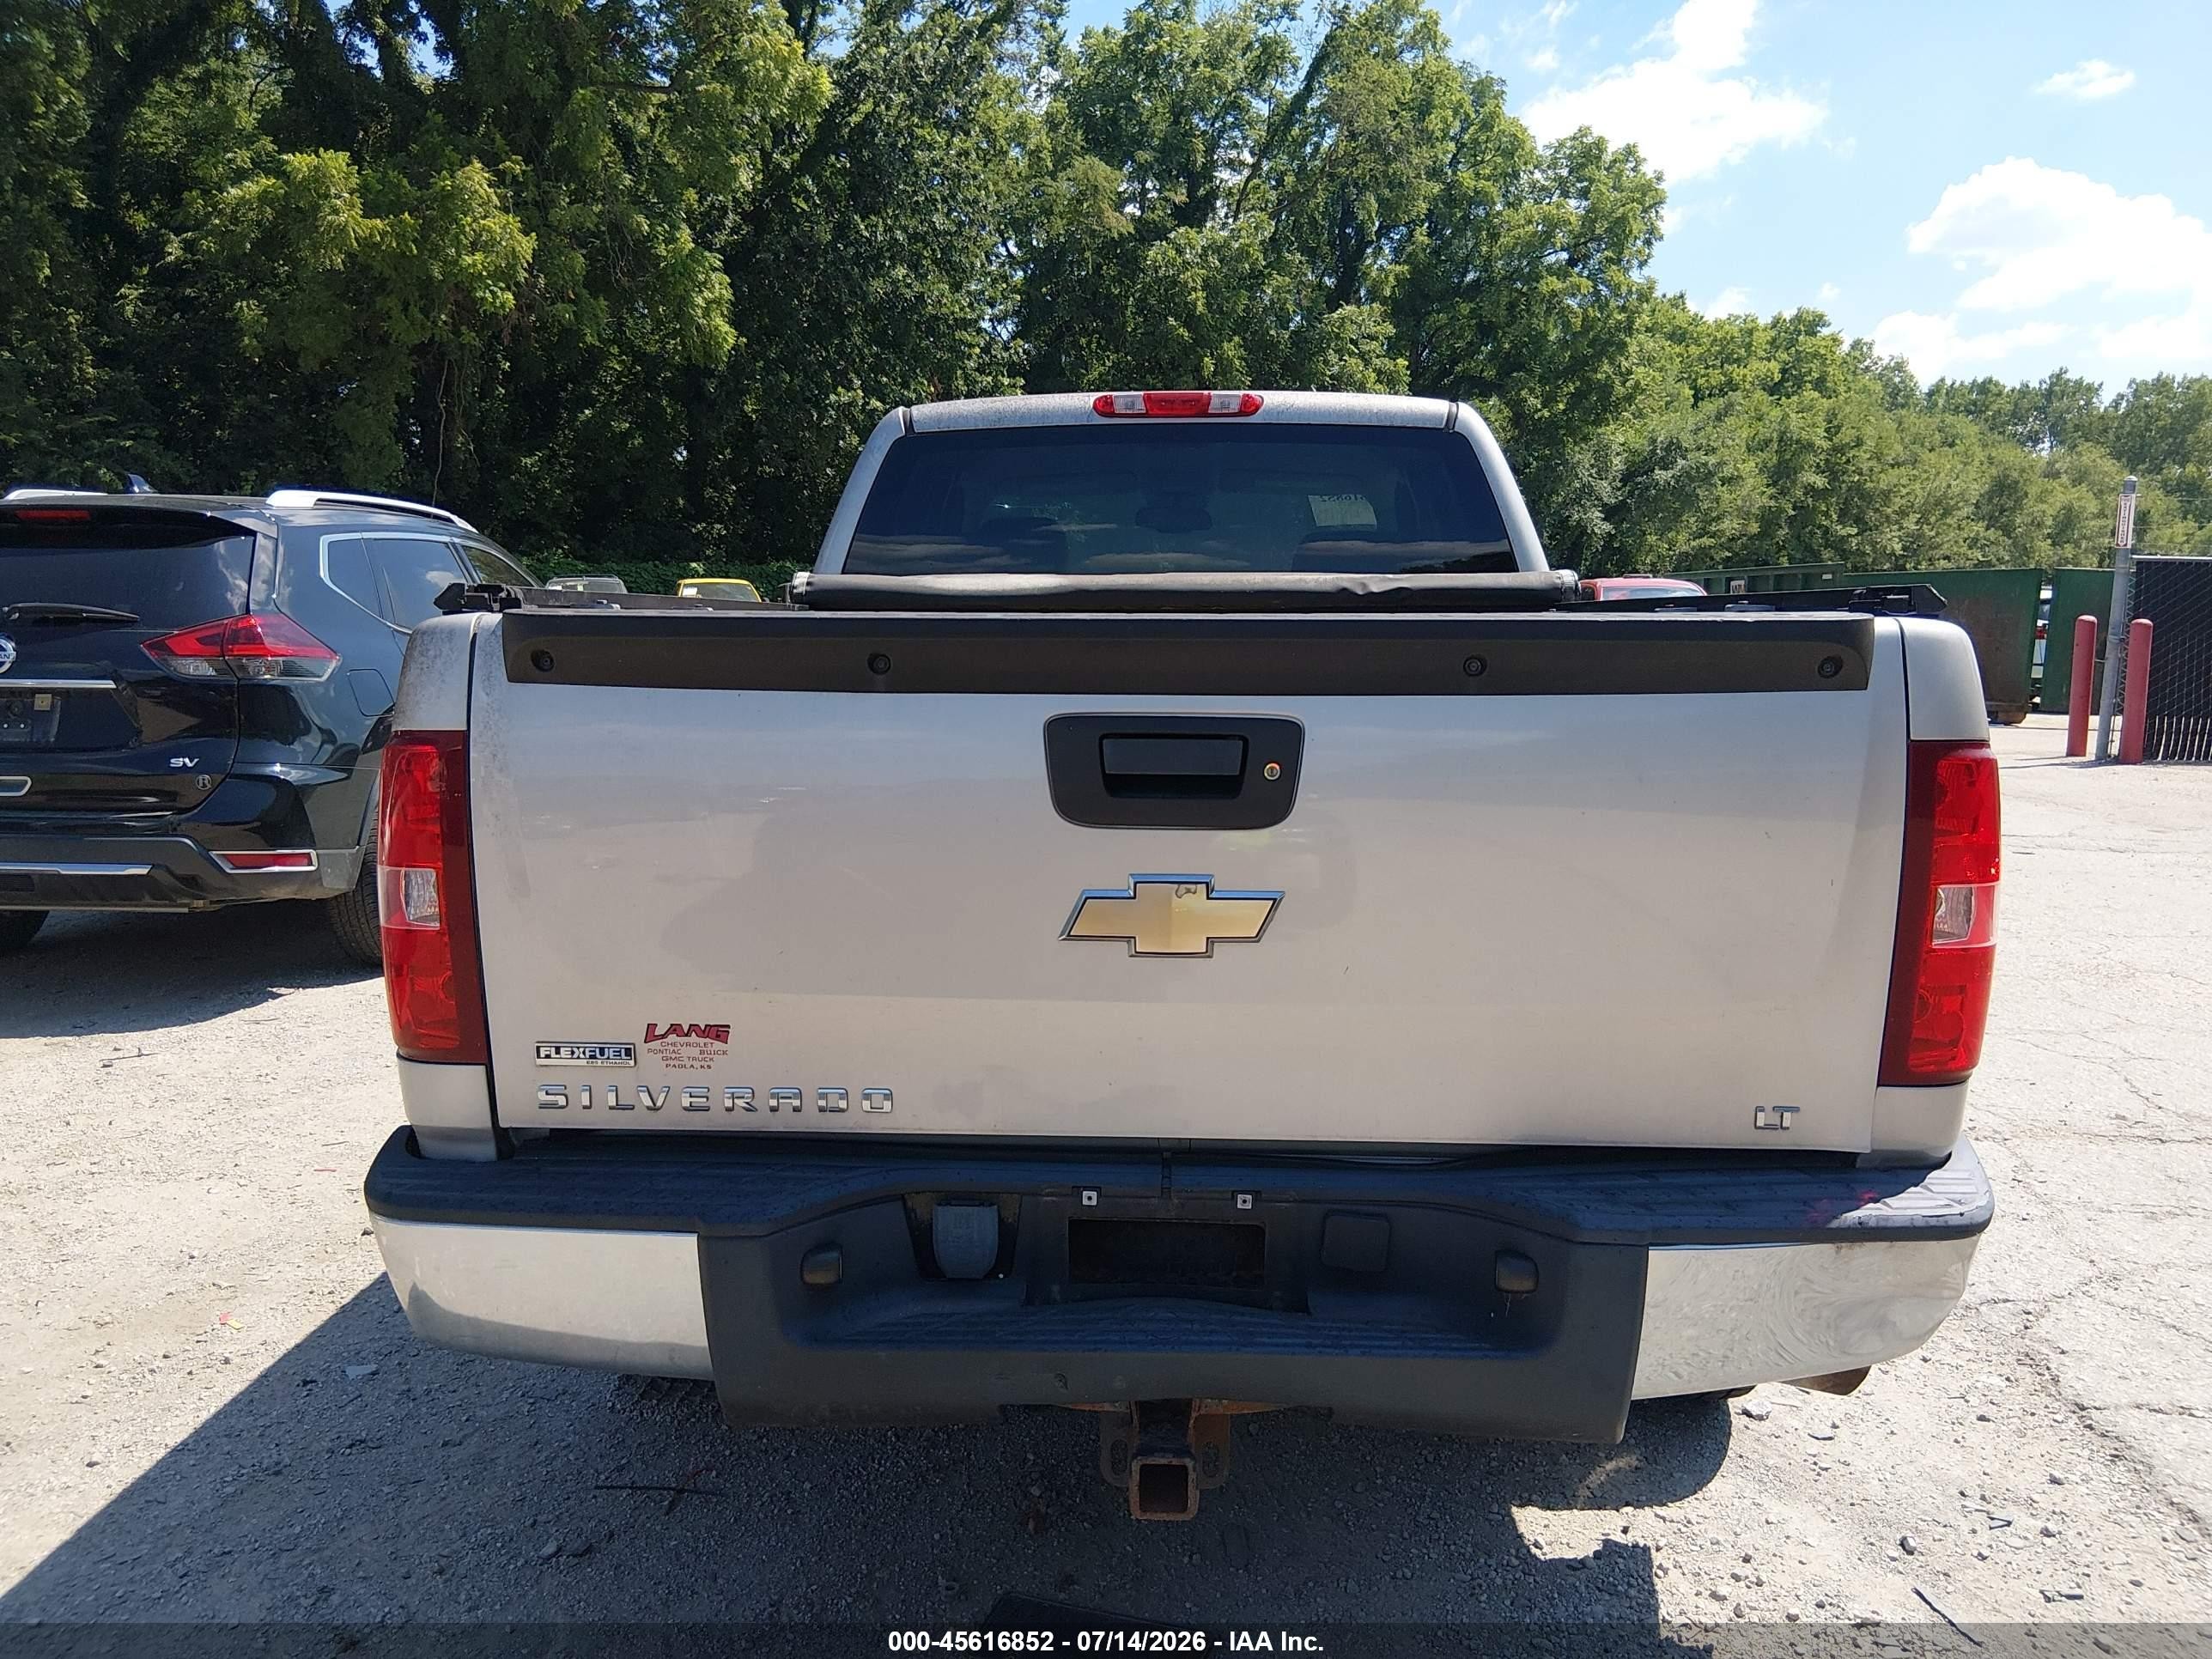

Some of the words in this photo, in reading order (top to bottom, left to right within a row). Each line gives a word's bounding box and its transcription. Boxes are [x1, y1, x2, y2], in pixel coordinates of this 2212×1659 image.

[170, 757, 199, 767] SV
[644, 1024, 731, 1044] LANG
[539, 1047, 631, 1060] FLEXFUEL
[538, 1084, 894, 1114] SILVERADO
[1754, 1106, 1800, 1130] LT
